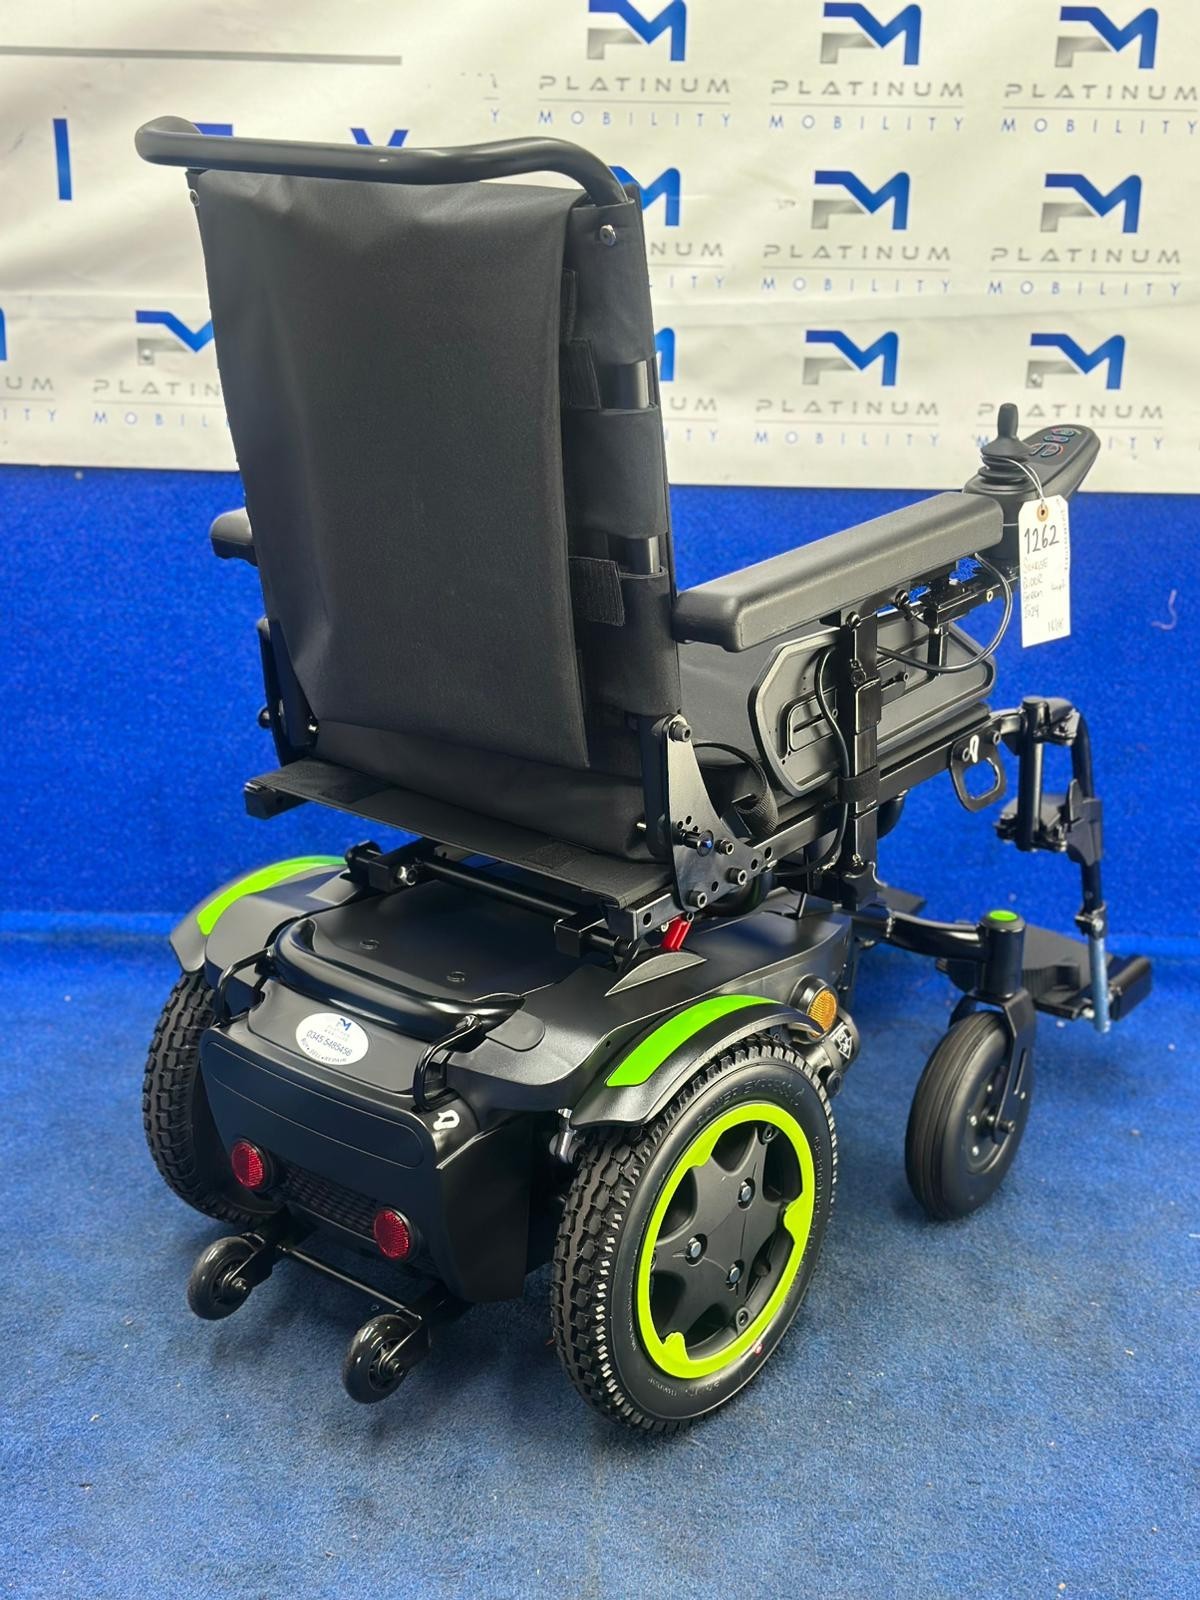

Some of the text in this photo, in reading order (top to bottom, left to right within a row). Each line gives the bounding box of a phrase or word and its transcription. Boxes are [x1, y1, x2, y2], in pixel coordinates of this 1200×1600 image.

[539, 75, 731, 94] PLATINUM
[771, 79, 964, 98] PLATINUM
[1003, 83, 1198, 101] PLATINUM
[538, 109, 731, 127] MOBILITY
[769, 114, 964, 131] MOBILITY
[1001, 118, 1198, 135] MOBILITY
[763, 243, 951, 262] PLATINUM
[990, 247, 1181, 265] PLATINUM
[761, 276, 951, 293] MOBILITY
[988, 280, 1181, 297] MOBILITY
[93, 379, 221, 397] PLATIN
[755, 399, 939, 417] PLATINUM
[977, 402, 1164, 420] PATINUM
[754, 430, 940, 447] MOBILITY
[1024, 524, 1059, 555] 1262
